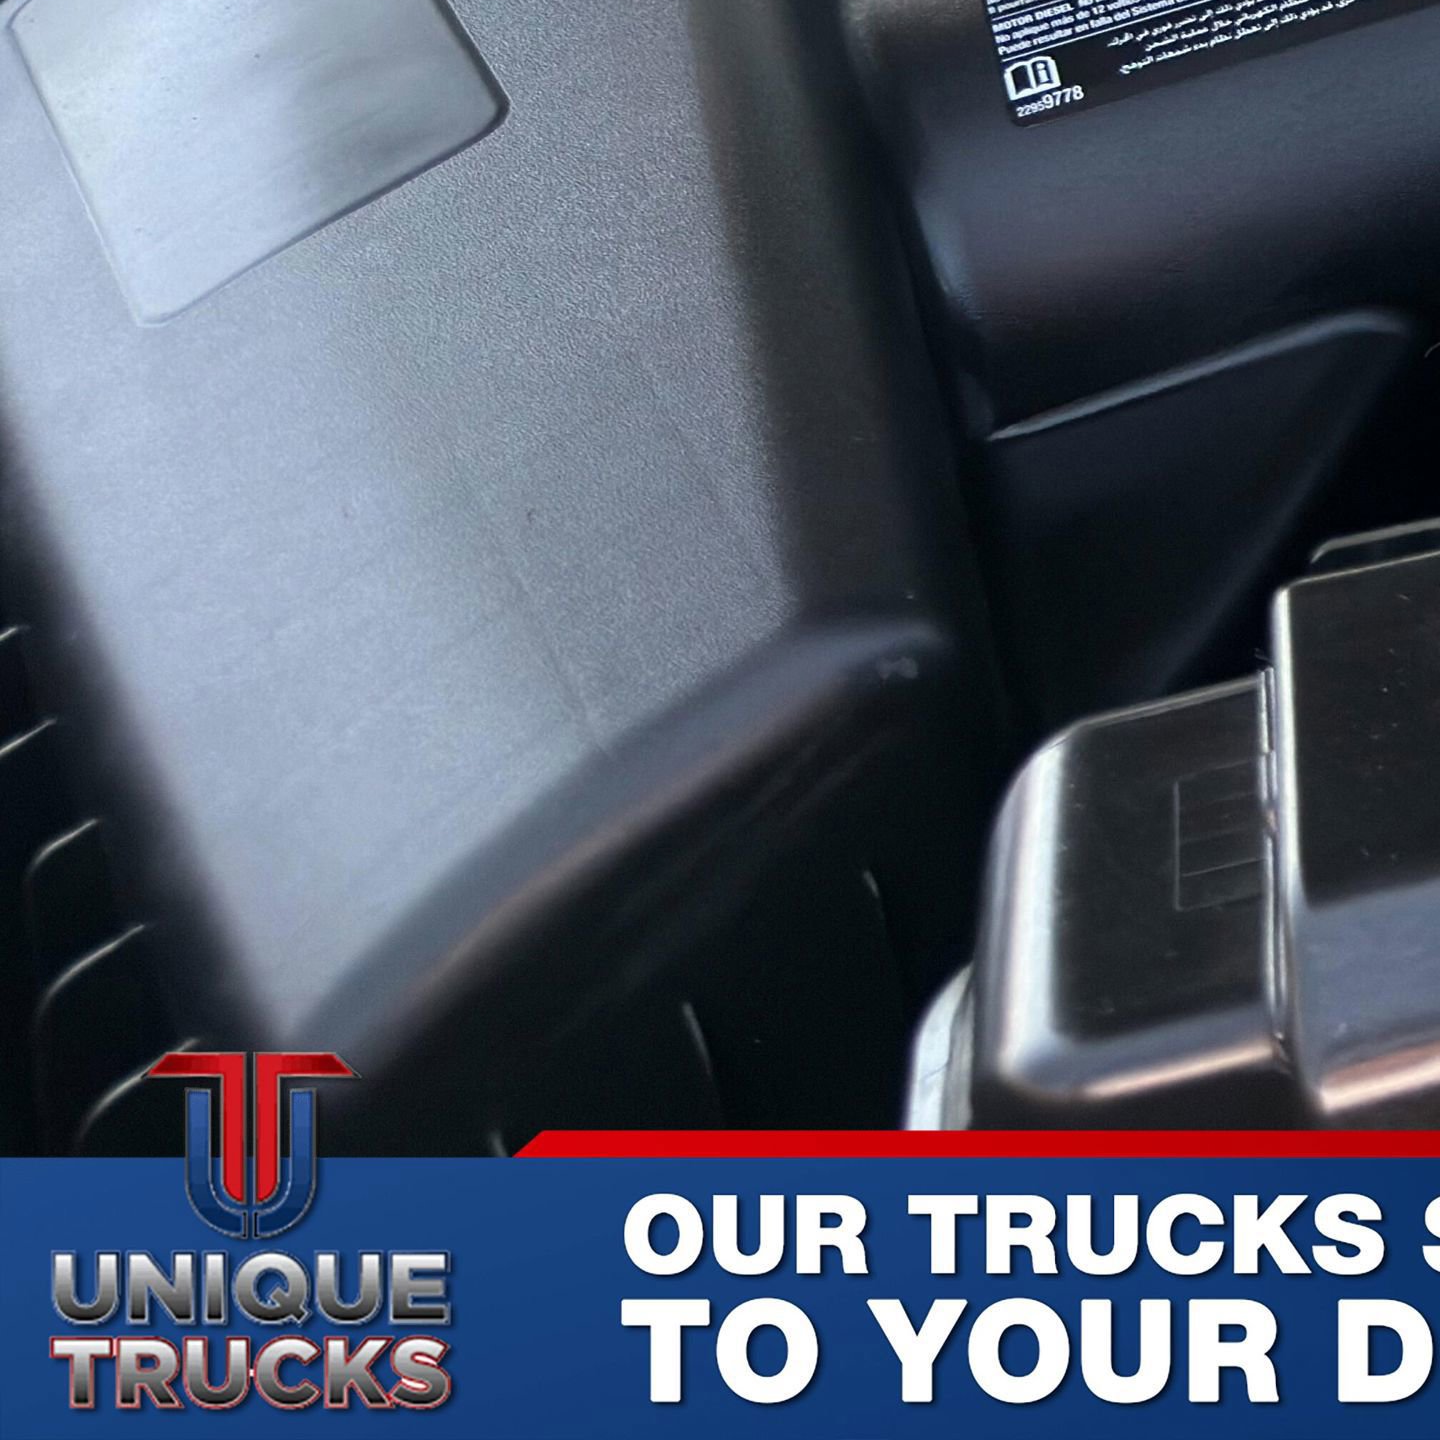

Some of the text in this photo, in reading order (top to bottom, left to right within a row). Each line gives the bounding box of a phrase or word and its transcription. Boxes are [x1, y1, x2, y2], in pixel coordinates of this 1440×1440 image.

[993, 14, 1032, 32] MOTOR
[1035, 2, 1073, 20] DIESEL
[1092, 5, 1105, 15] 12
[998, 39, 1030, 56] Puede
[1075, 22, 1088, 33] en
[1114, 9, 1129, 21] del
[1015, 85, 1084, 118] 22959778
